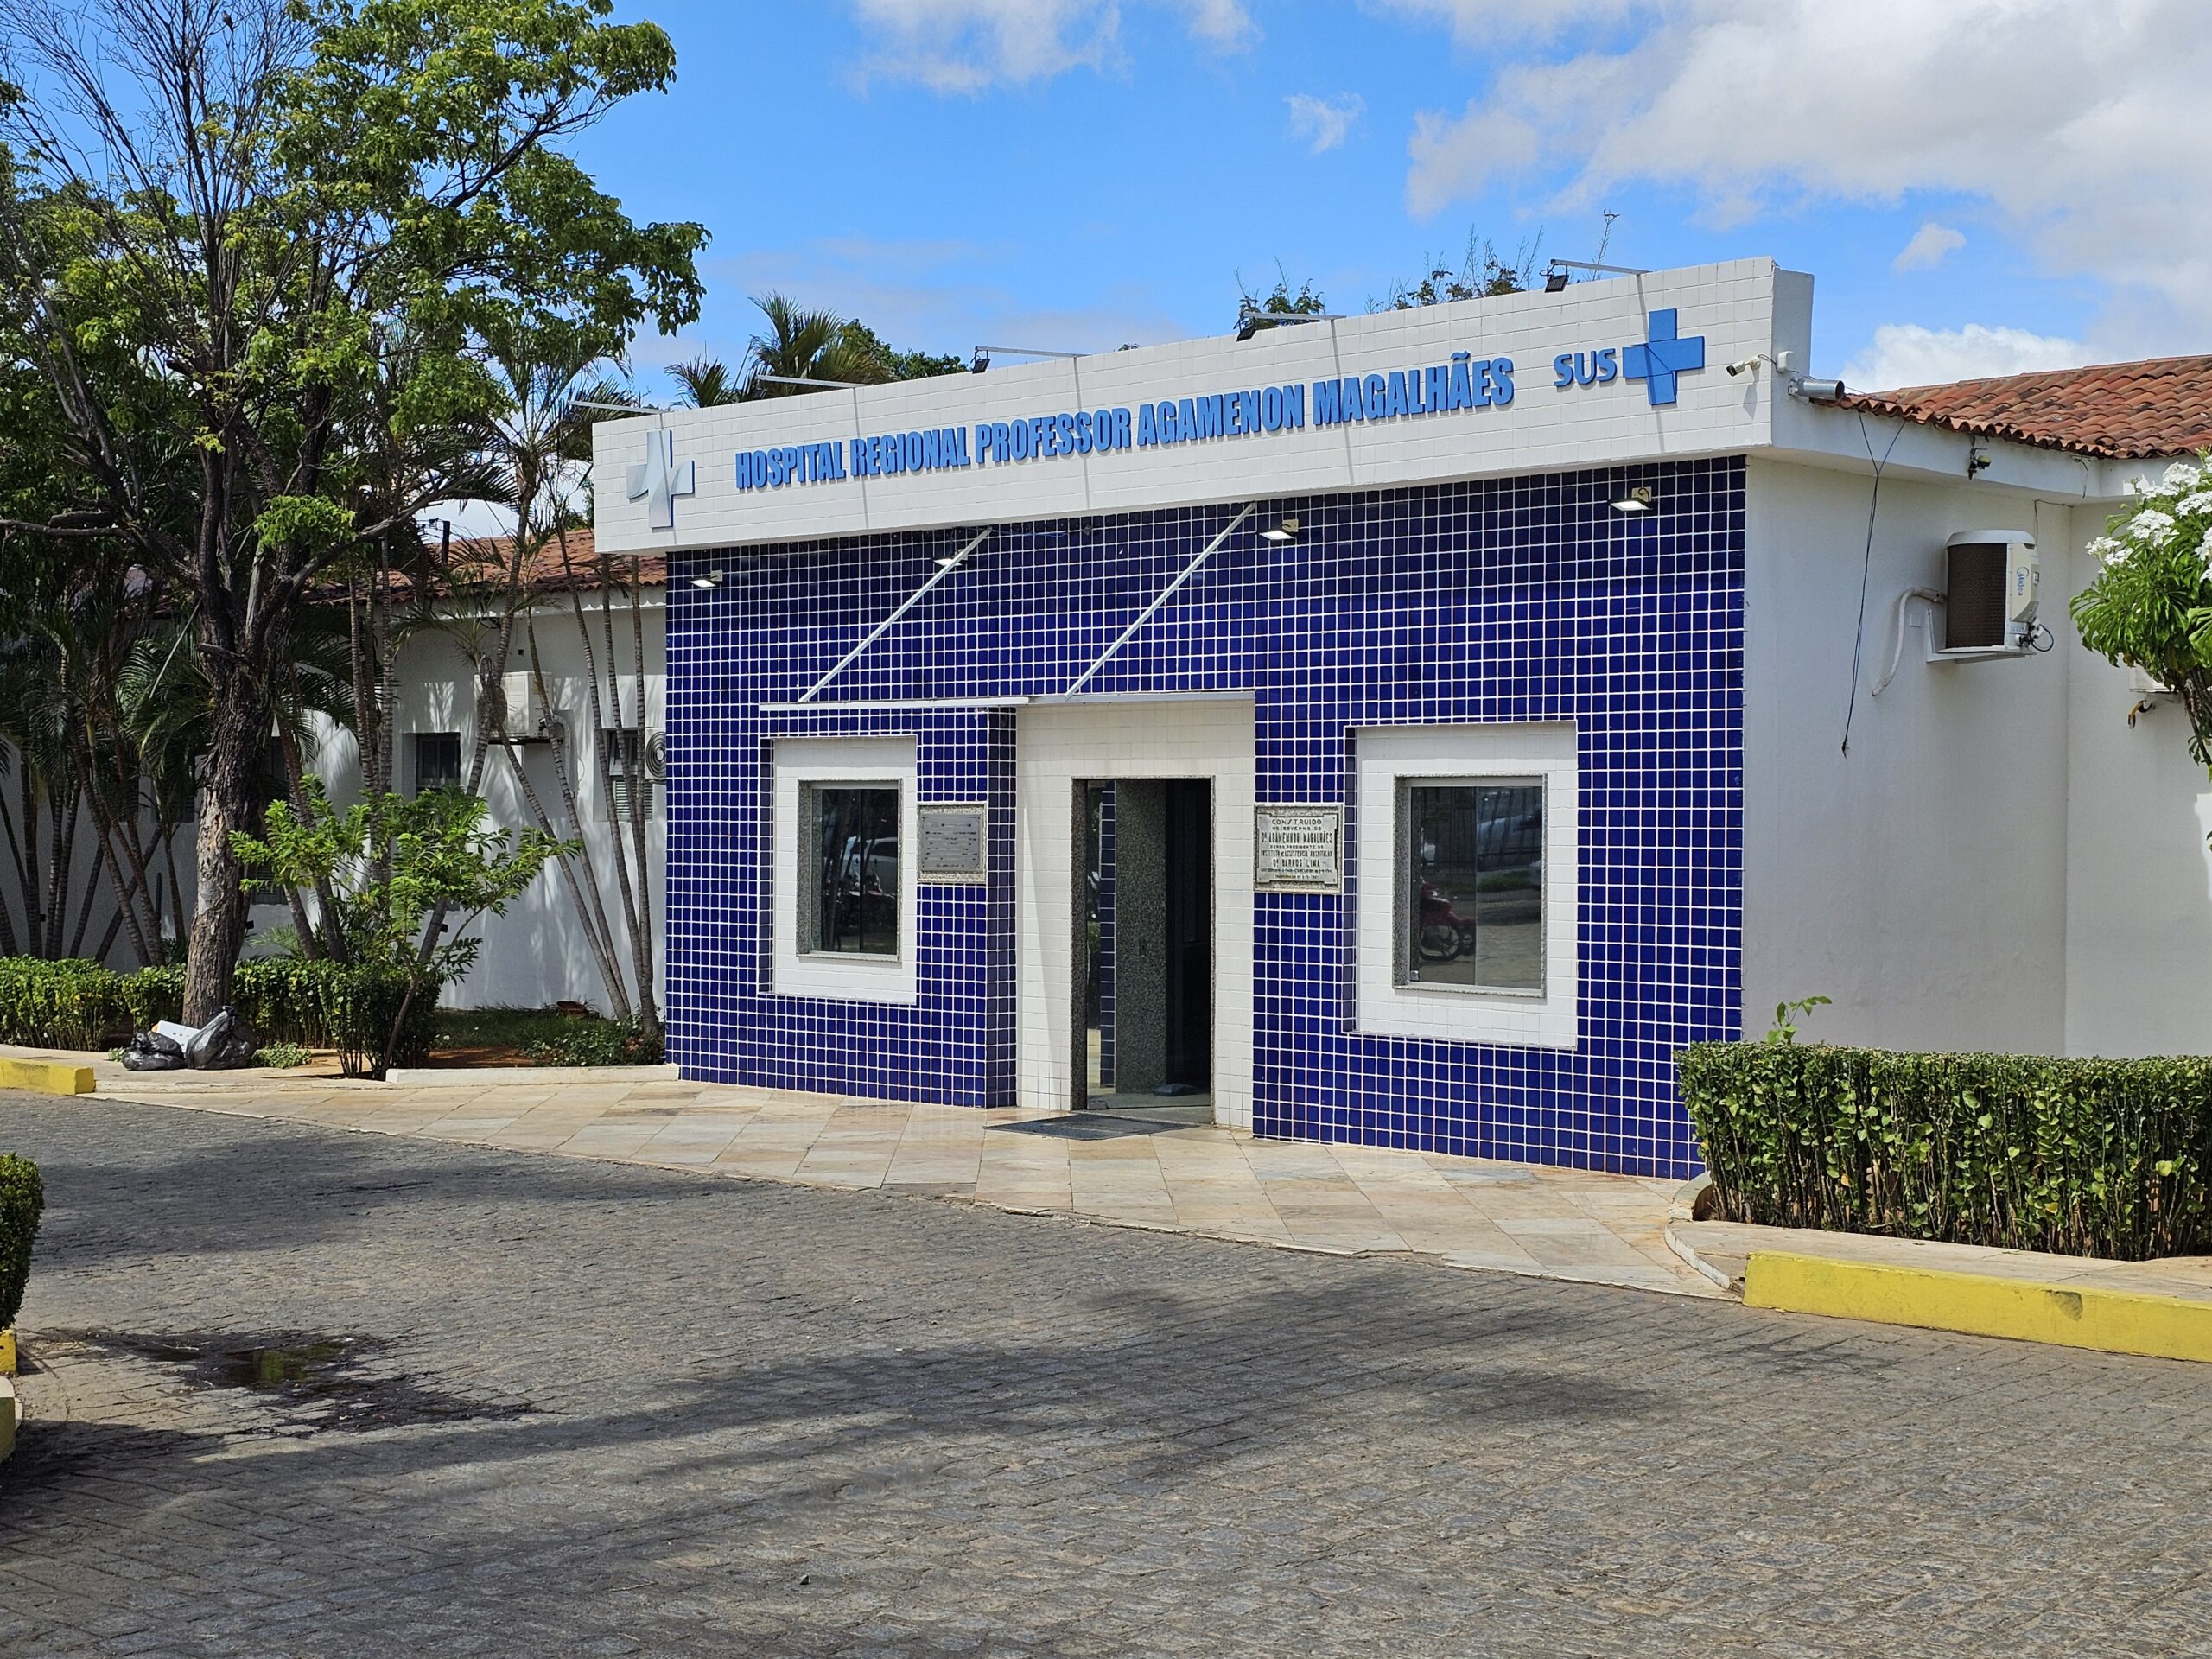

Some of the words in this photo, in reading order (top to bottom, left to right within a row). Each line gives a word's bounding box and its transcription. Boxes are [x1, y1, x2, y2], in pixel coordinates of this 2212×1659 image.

[1554, 347, 1617, 388] SUS
[735, 441, 846, 490] HOSPITAL
[850, 426, 970, 476] REGIONAL
[976, 406, 1131, 463] PROFESSOR
[1137, 383, 1305, 446] AGAMENON
[1313, 349, 1514, 425] MAGALHÃES
[1306, 859, 1320, 868] LIMA
